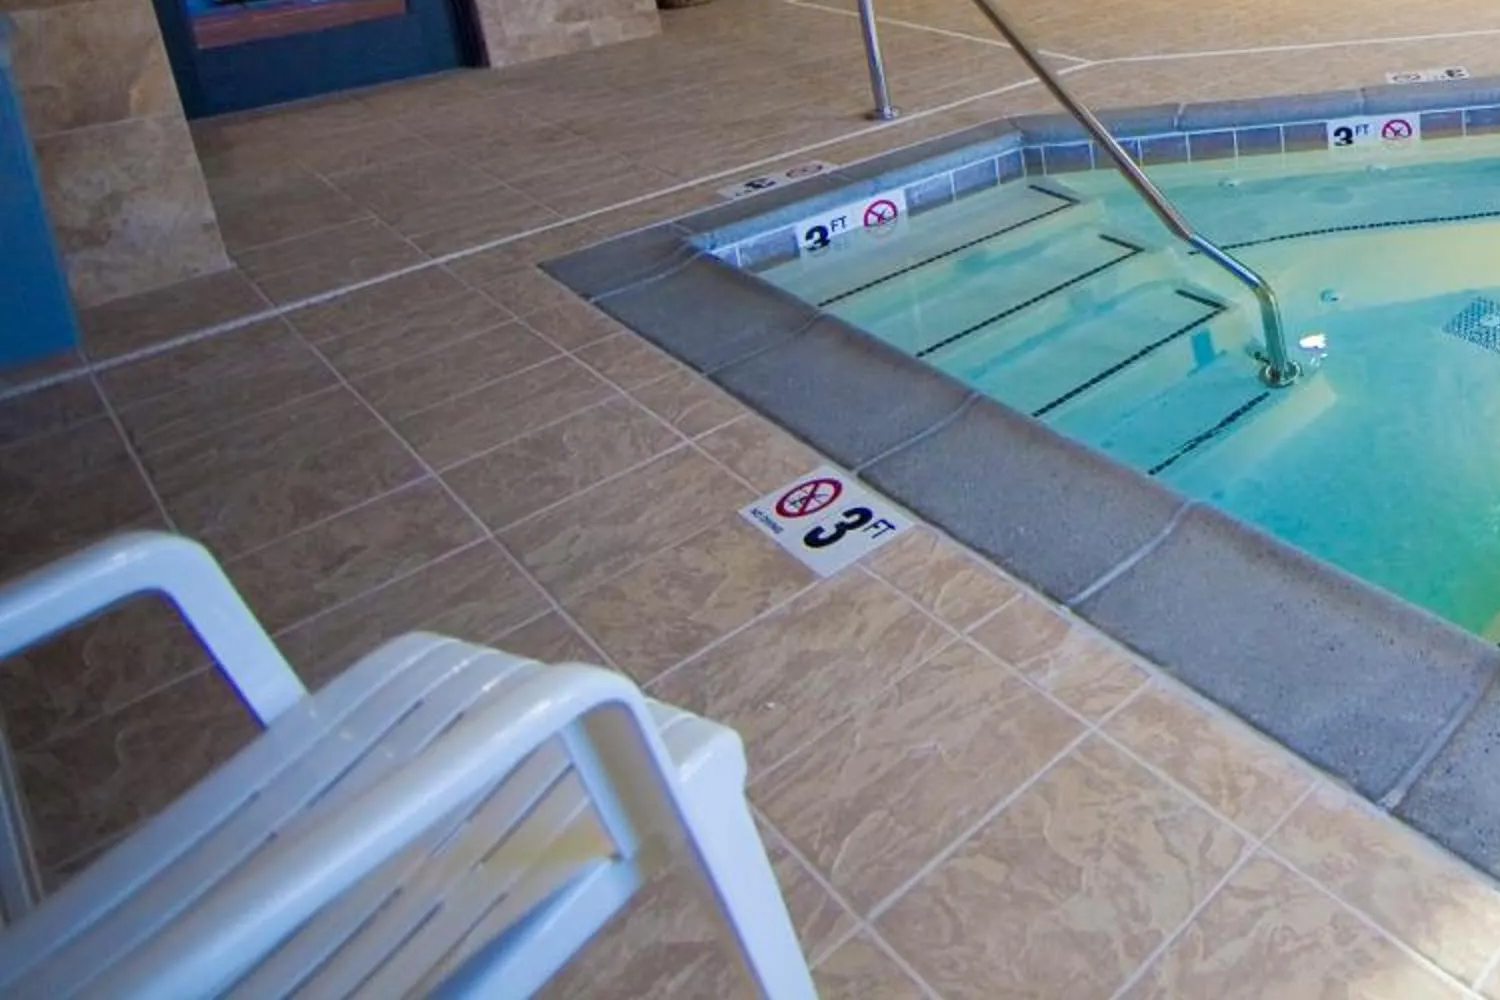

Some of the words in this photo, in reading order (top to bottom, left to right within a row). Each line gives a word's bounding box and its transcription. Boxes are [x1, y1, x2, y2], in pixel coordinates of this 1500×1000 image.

[1333, 126, 1354, 146] 3
[804, 224, 831, 252] 3
[831, 215, 848, 232] FT
[803, 507, 873, 549] 3
[861, 518, 897, 540] FT
